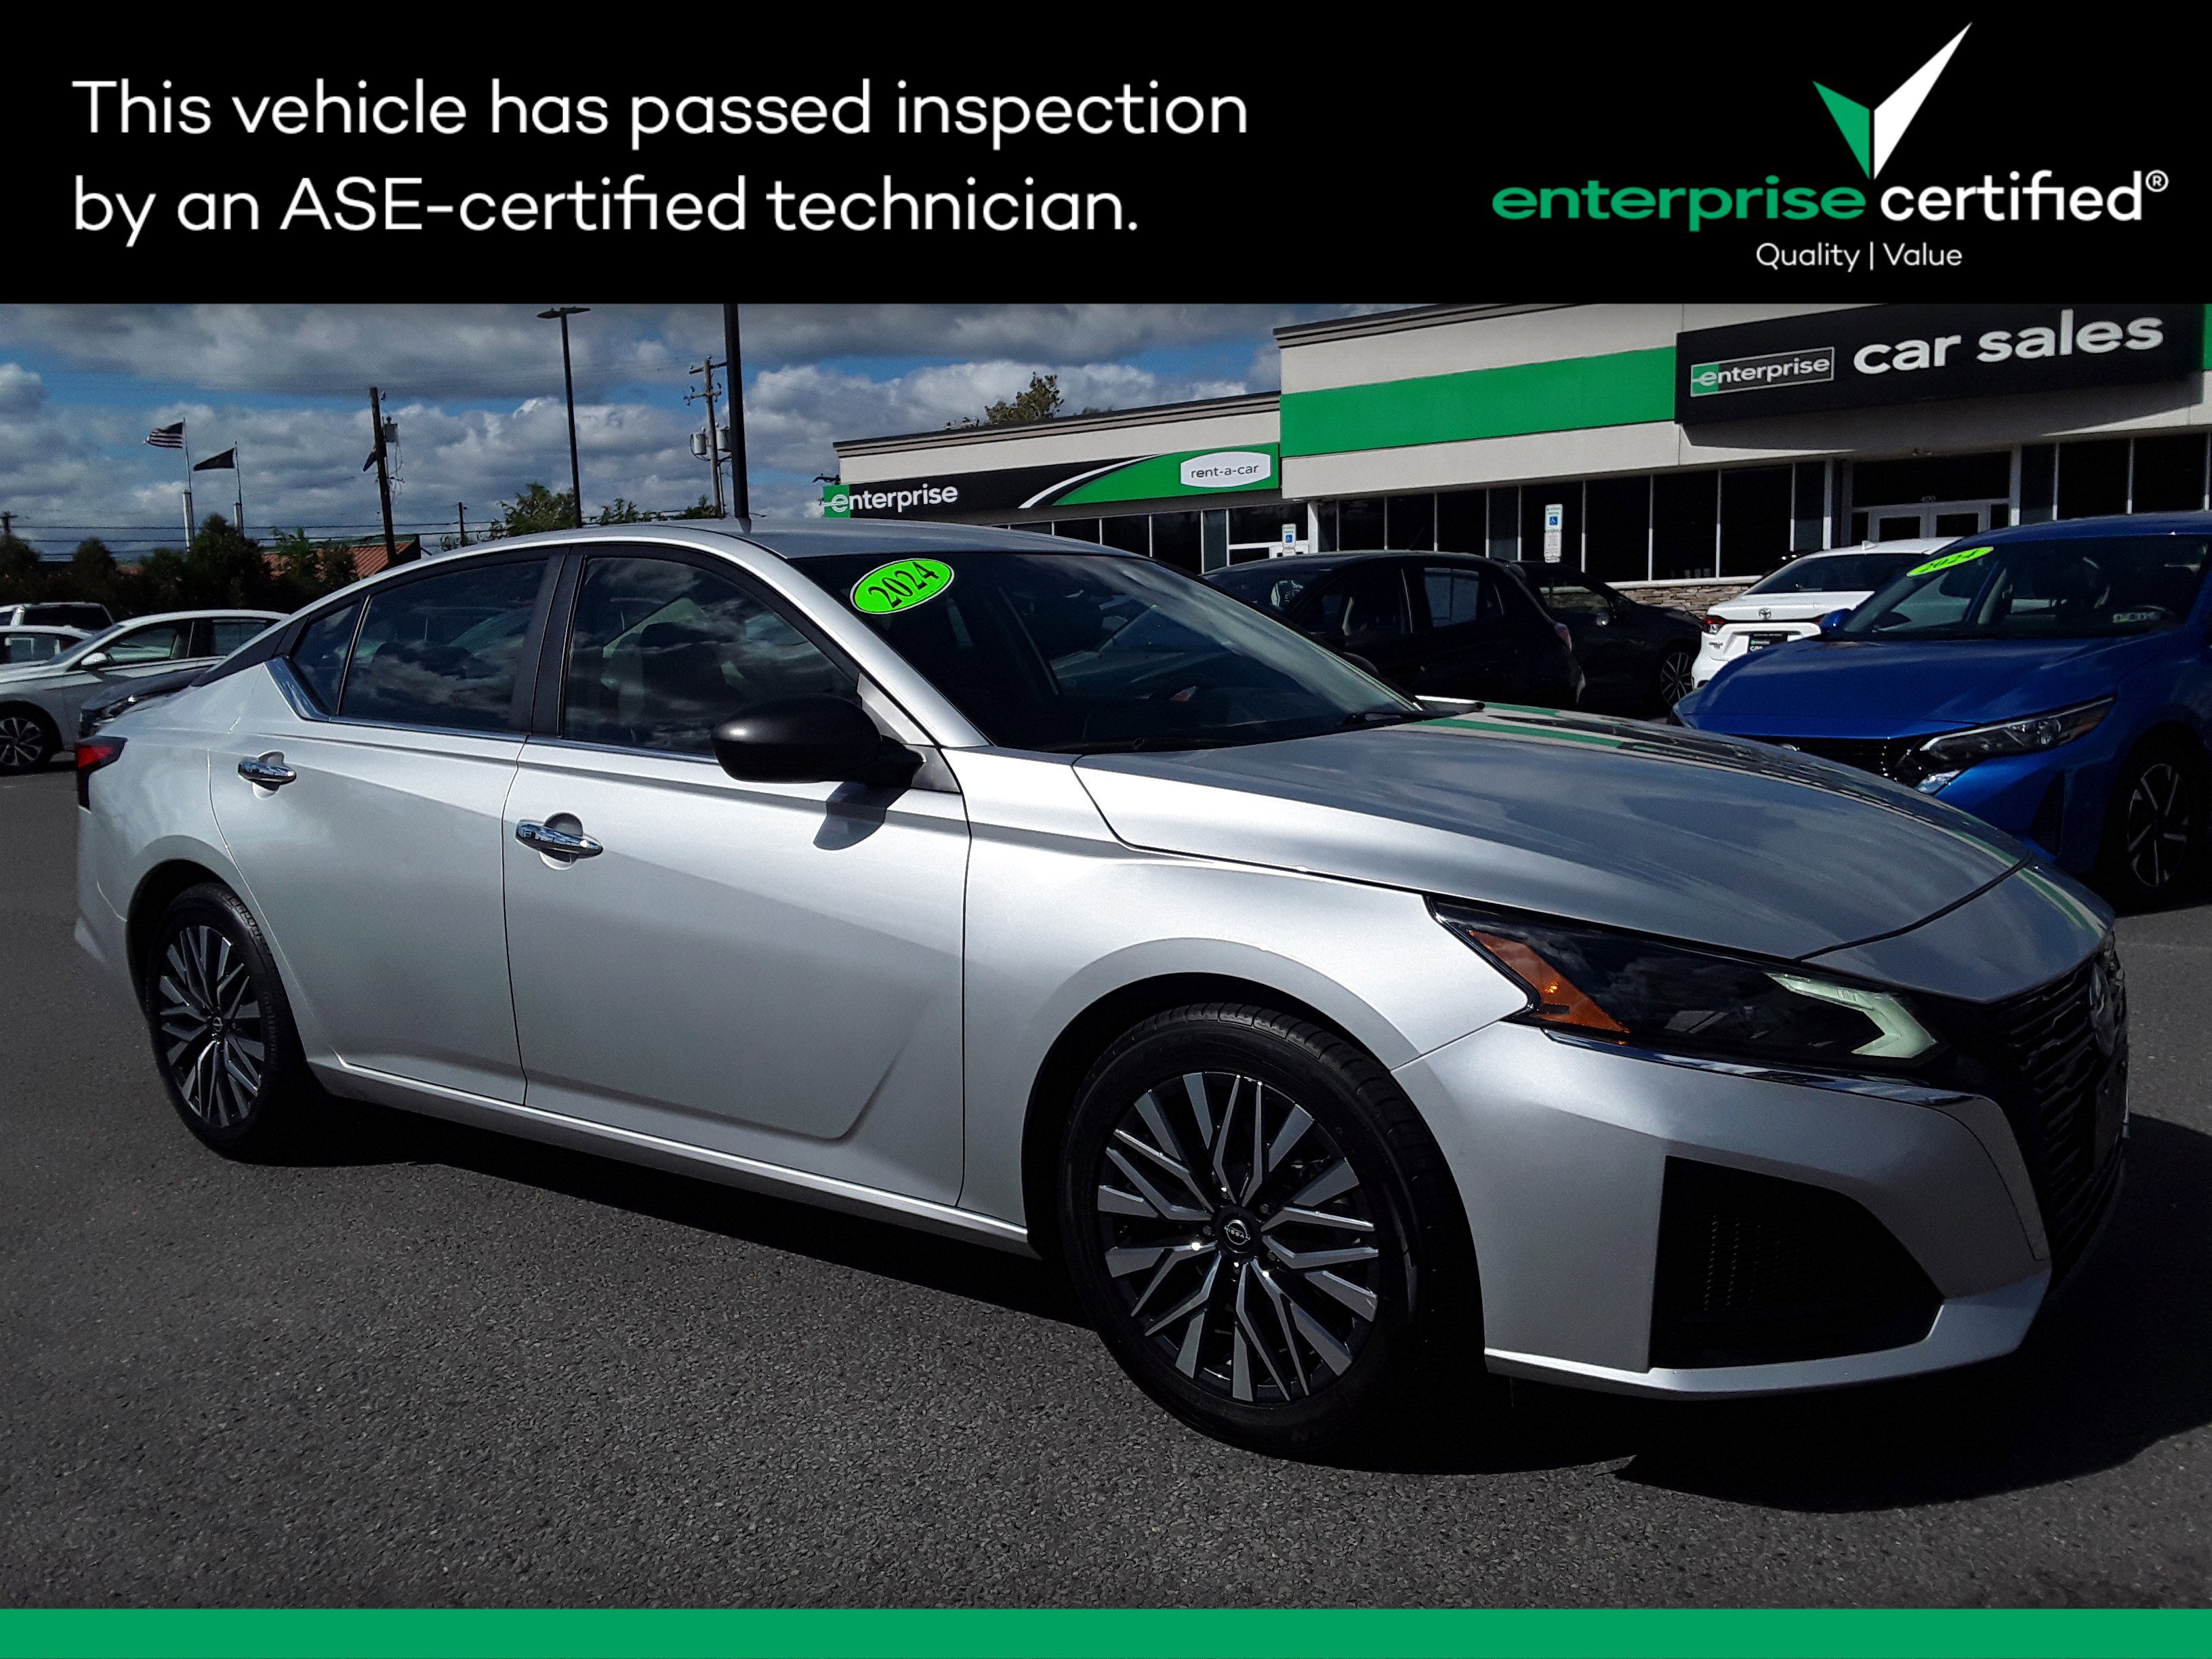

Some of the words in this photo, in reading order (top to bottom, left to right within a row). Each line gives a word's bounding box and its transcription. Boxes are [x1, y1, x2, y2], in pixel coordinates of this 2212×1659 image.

[1700, 357, 1830, 387] enterprise
[1853, 335, 1962, 375] car
[1976, 308, 2164, 363] sales
[1191, 465, 1259, 478] rent-a-car
[830, 483, 958, 513] enterprise
[867, 561, 940, 609] 2024
